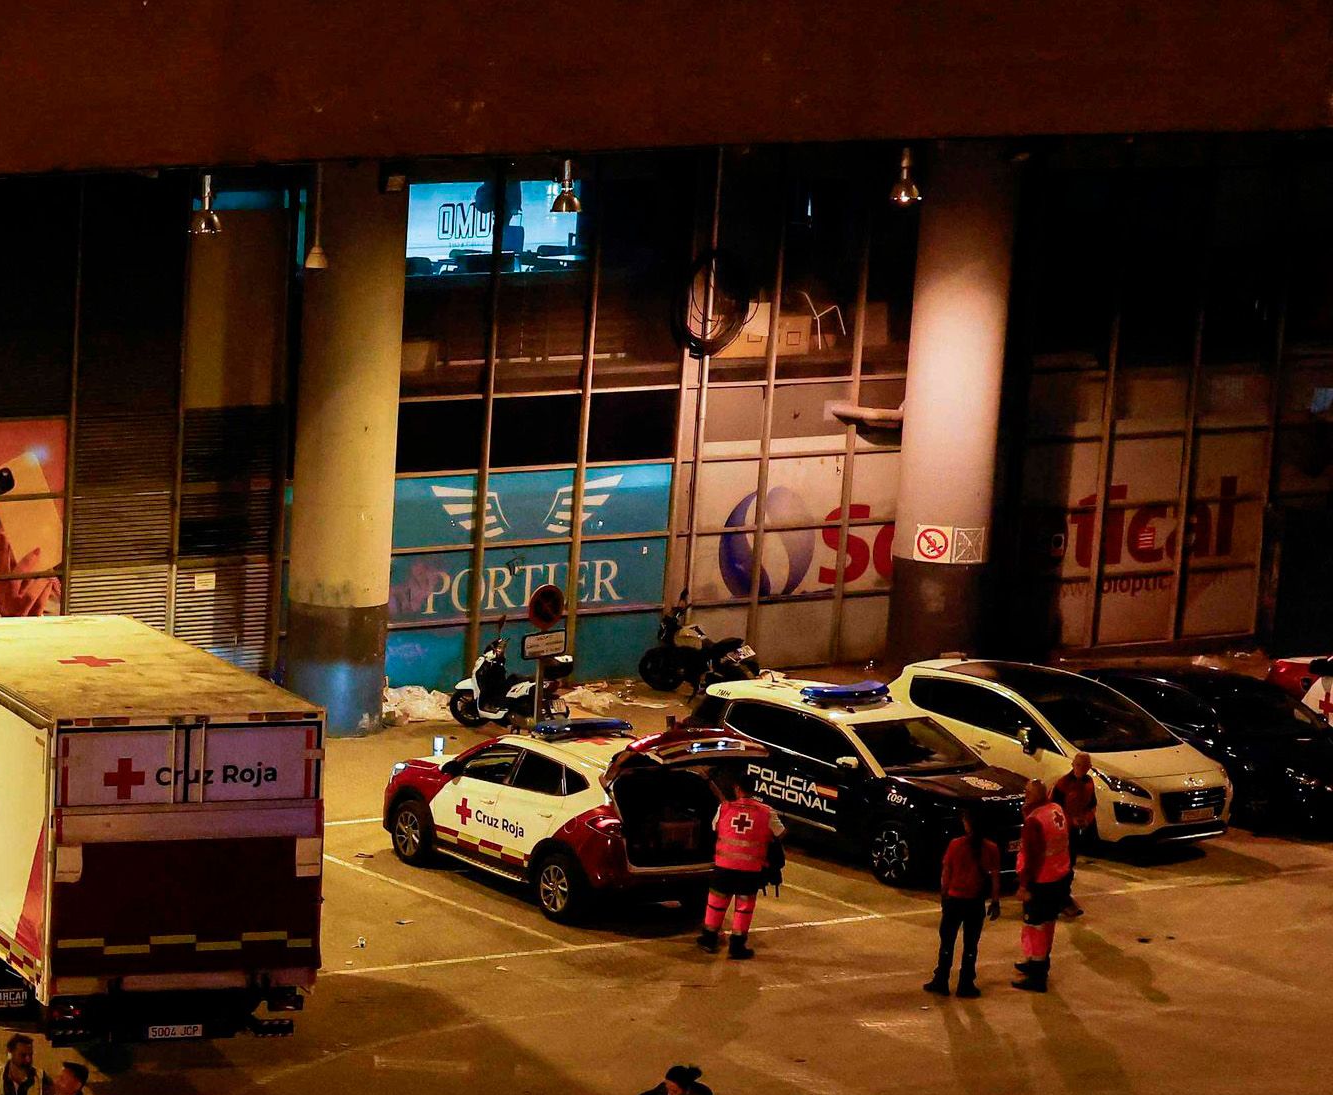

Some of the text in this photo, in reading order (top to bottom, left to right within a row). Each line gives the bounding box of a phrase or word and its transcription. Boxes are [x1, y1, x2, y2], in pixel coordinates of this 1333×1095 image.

[155, 761, 278, 787] Cruz Roja
[475, 809, 525, 838] Cruz Roja
[151, 1027, 177, 1037] 5004
